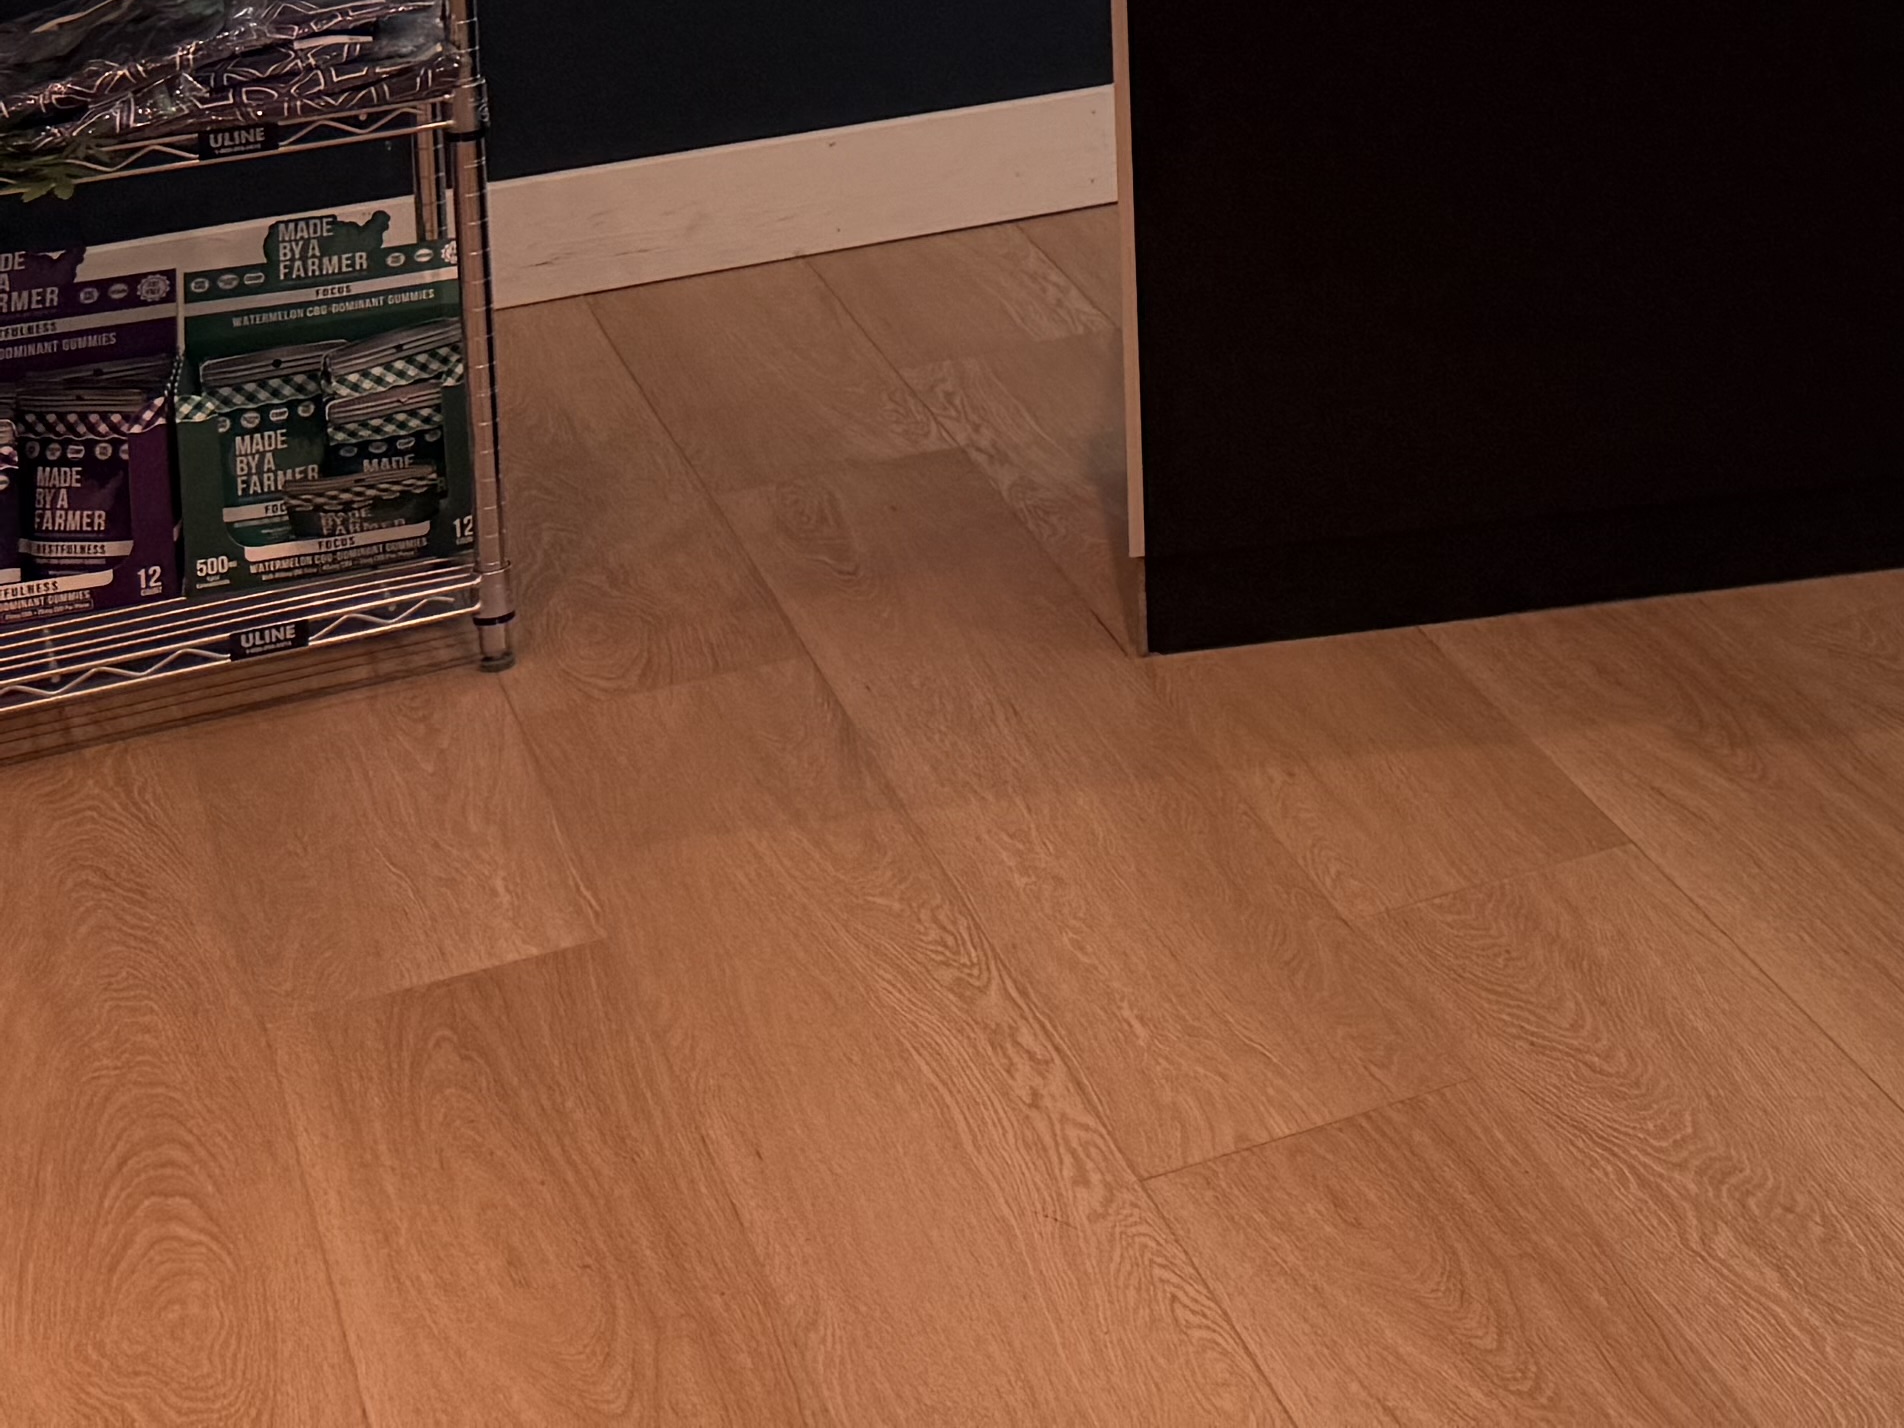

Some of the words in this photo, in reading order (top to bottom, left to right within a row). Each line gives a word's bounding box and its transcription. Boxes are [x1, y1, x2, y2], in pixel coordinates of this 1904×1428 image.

[209, 128, 265, 148] ULINE
[278, 217, 335, 243] MADE
[278, 241, 304, 262] BY
[307, 240, 321, 258] A
[0, 251, 27, 274] DE
[278, 251, 368, 281] FARMER
[0, 287, 60, 313] RMER
[315, 284, 353, 299] FOCUS
[231, 304, 305, 328] WATERMELON
[387, 288, 435, 309] GUMMIES
[62, 332, 118, 352] GUMMIES
[234, 429, 289, 457] MADE
[236, 454, 261, 477] BY
[263, 451, 277, 472] A
[362, 453, 417, 474] MADE
[36, 466, 83, 488] MADE
[34, 487, 56, 509] BY
[57, 487, 69, 509] A
[34, 510, 106, 531] FARMER
[263, 505, 289, 517] FOC
[453, 515, 475, 539] 12
[318, 535, 357, 551] FOCUS
[137, 565, 162, 590] 12
[241, 625, 296, 648] ULINE
